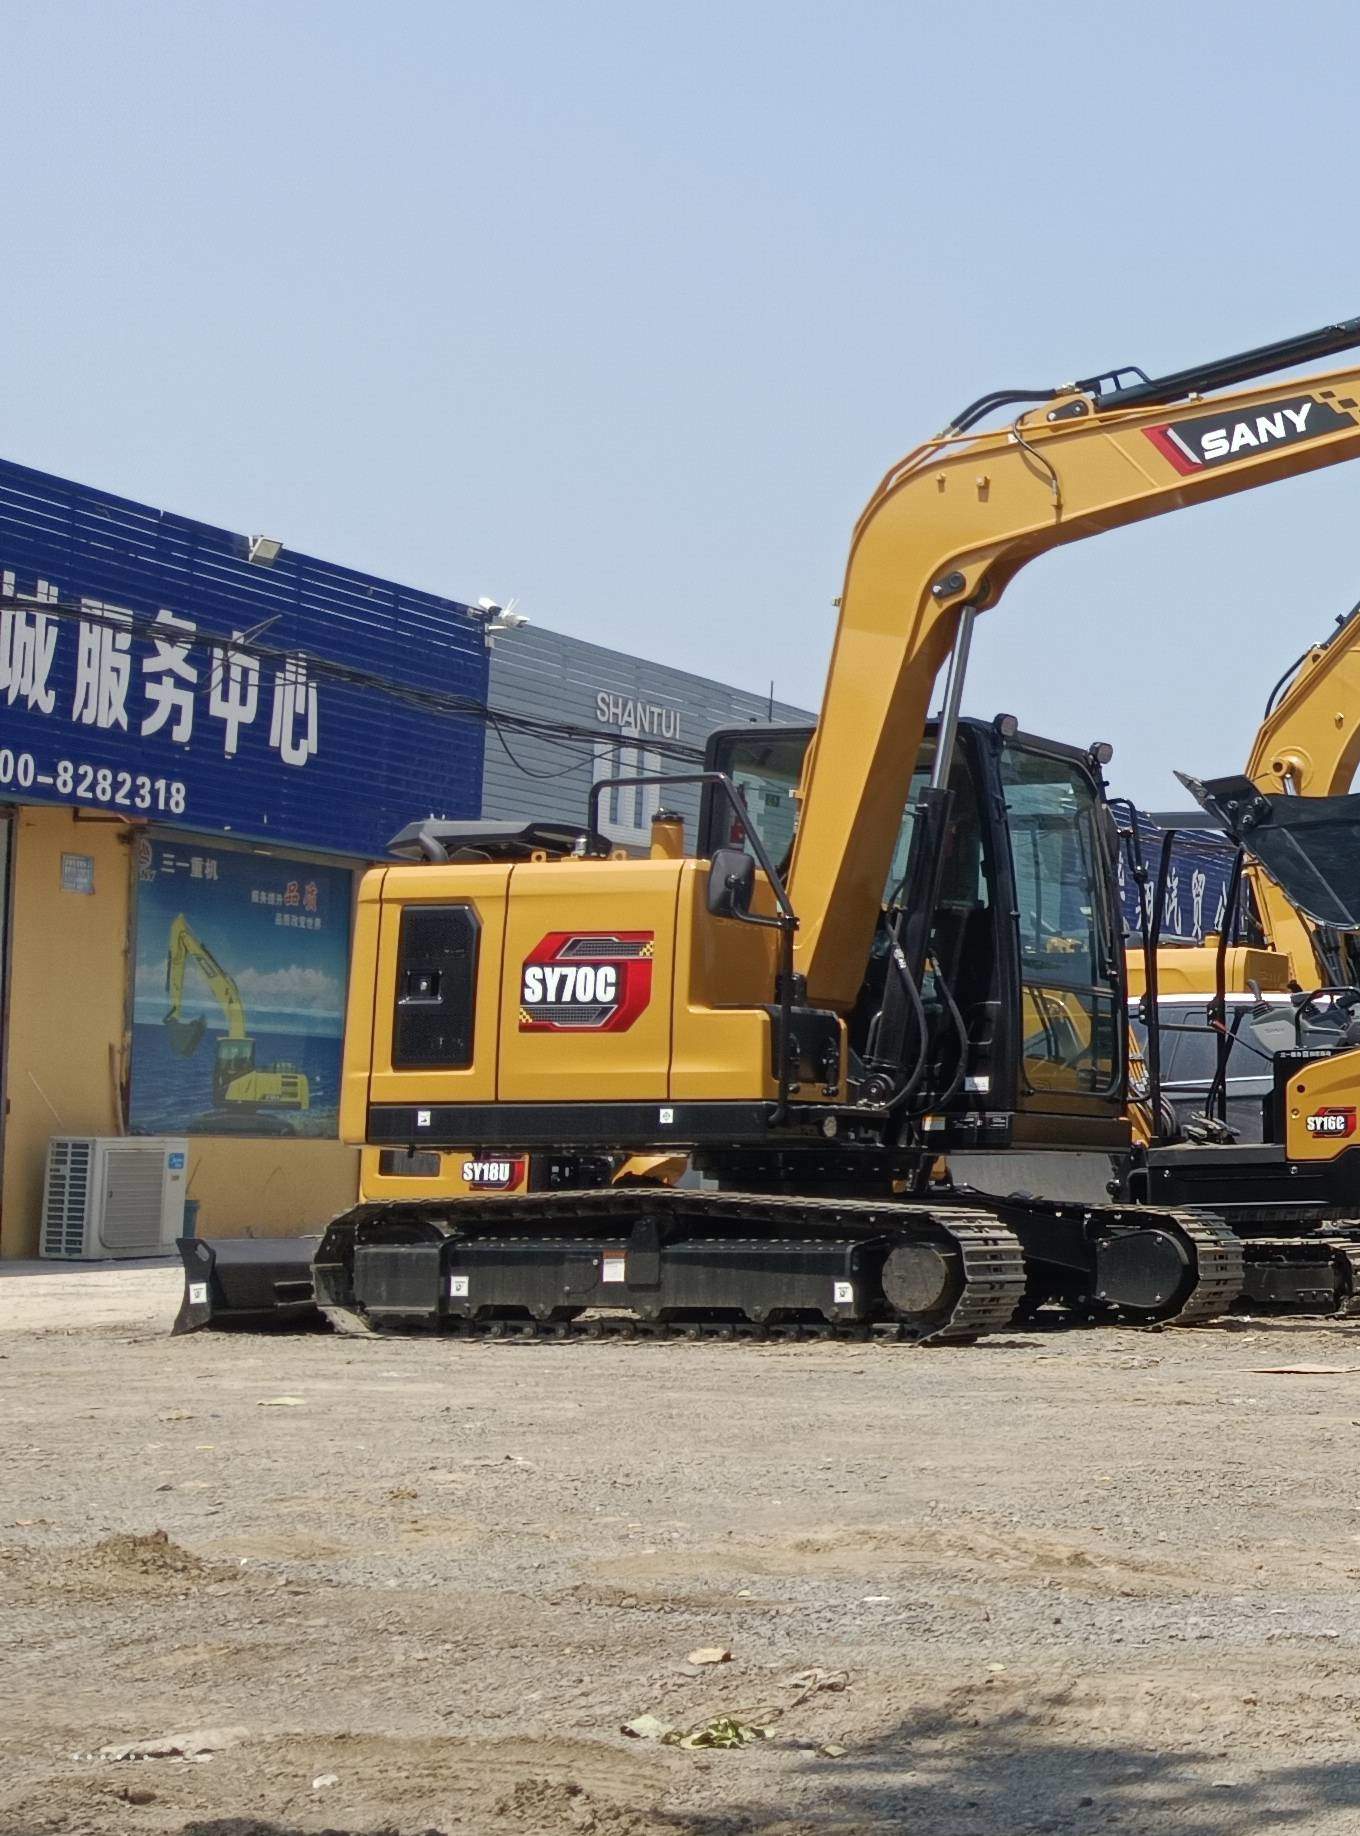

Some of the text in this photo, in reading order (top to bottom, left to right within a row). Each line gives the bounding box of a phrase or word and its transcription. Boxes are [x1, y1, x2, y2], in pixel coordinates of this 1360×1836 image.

[1200, 402, 1312, 460] SANY
[596, 692, 680, 740] SHANTUI
[0, 748, 187, 815] 00-8282318
[161, 852, 219, 880] 三一重机
[523, 966, 617, 1003] SY70C
[1306, 1115, 1345, 1132] SY16C
[462, 1162, 511, 1182] SY18U
